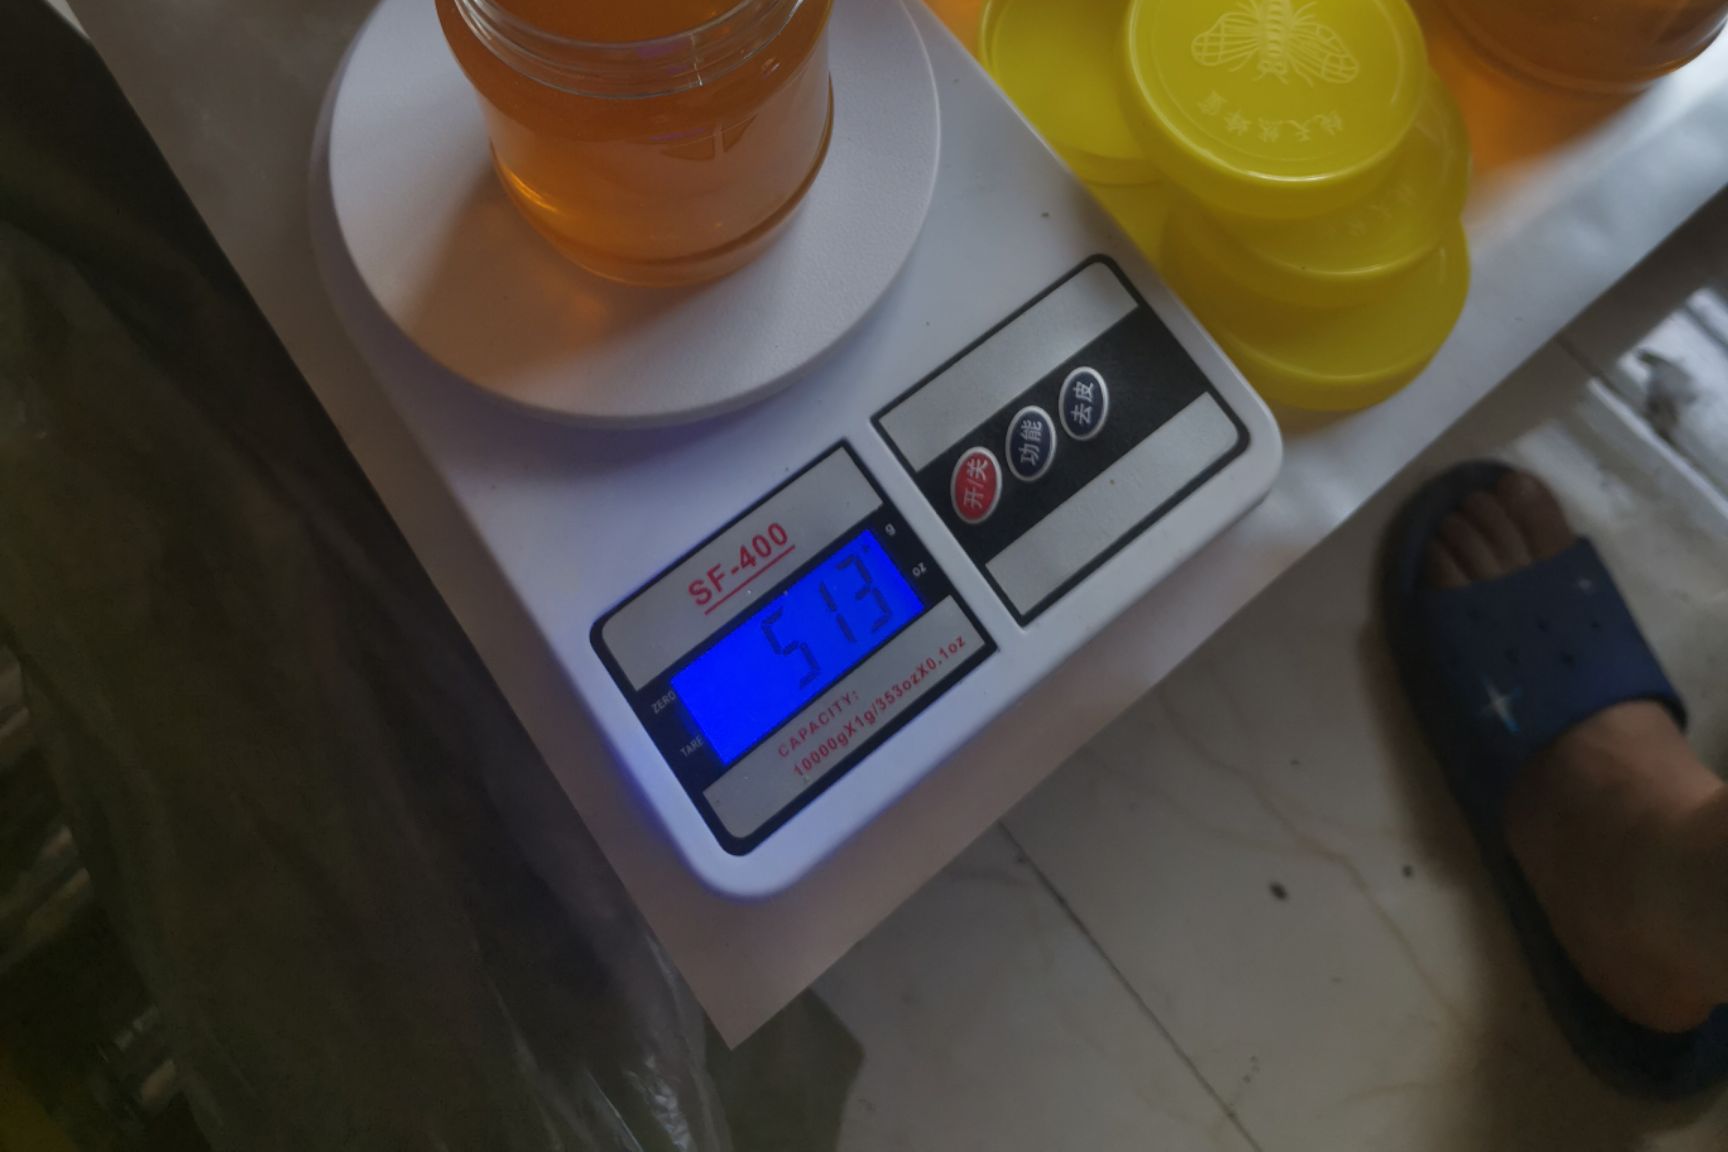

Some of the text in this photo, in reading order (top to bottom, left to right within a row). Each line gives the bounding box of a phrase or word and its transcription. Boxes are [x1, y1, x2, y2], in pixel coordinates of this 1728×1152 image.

[1070, 380, 1094, 424] 去皮
[1018, 419, 1042, 466] 功能
[963, 458, 988, 509] 开/关
[885, 523, 896, 536] g
[688, 523, 788, 606] SF-400
[912, 561, 927, 578] oz
[761, 554, 892, 687] 513
[651, 690, 677, 714] ZERO
[778, 690, 859, 758] CAPACITY:
[794, 636, 966, 777] 10000gX1g/353ozX0.1oz
[680, 734, 704, 757] TARE
